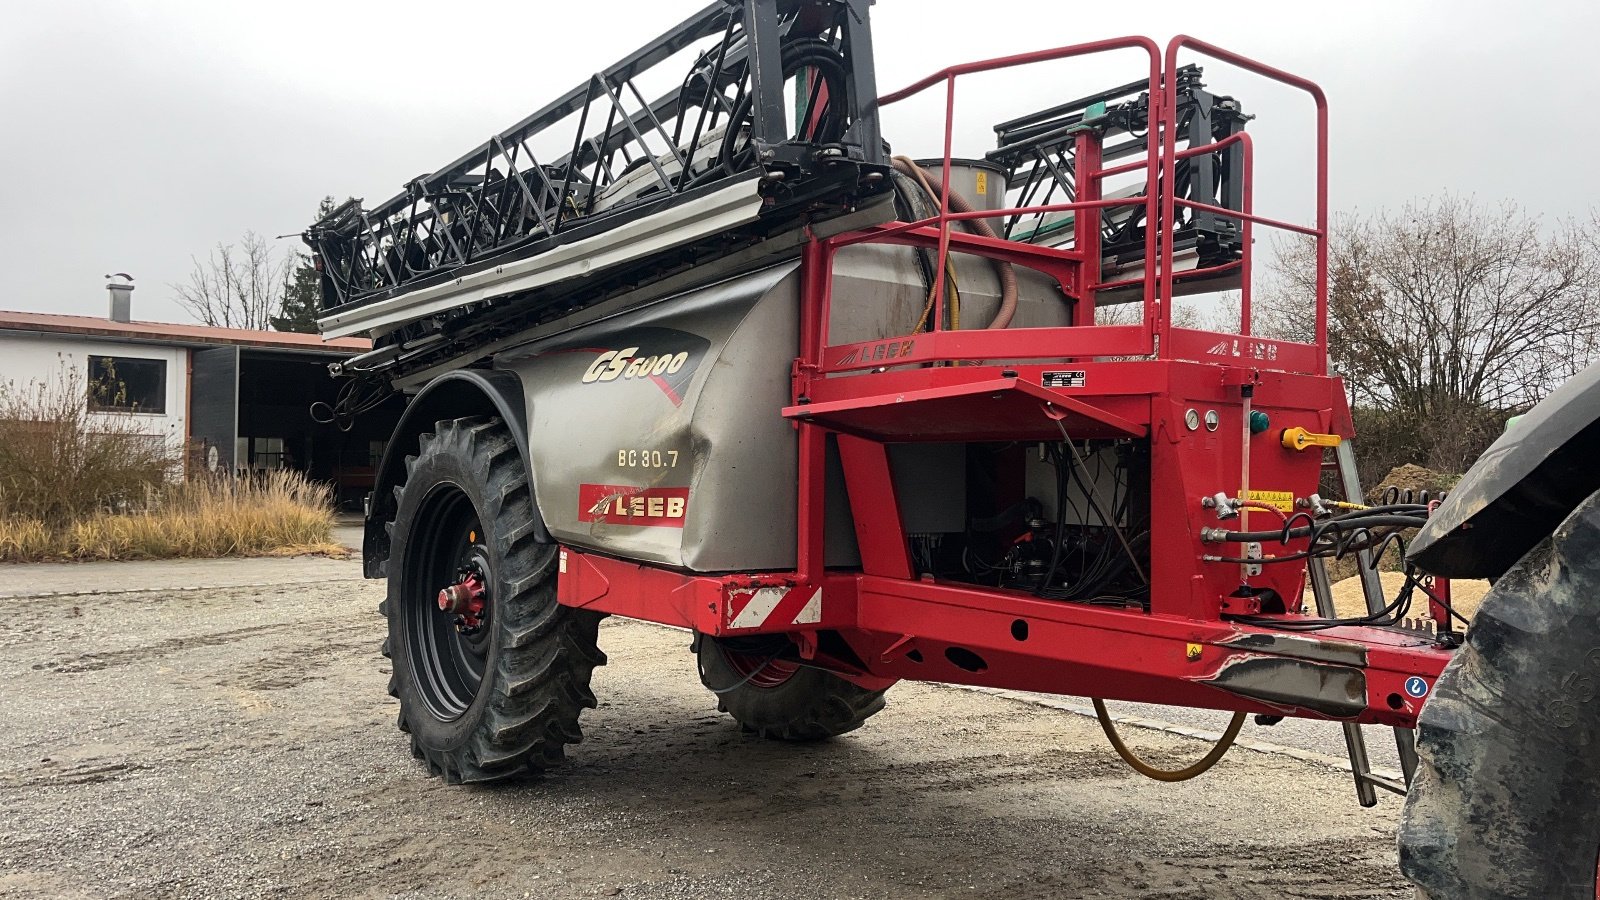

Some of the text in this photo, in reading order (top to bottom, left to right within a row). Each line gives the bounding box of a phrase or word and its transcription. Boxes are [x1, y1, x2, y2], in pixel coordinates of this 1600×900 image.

[618, 449, 678, 468] BC 30.7
[616, 496, 684, 518] LEEB
